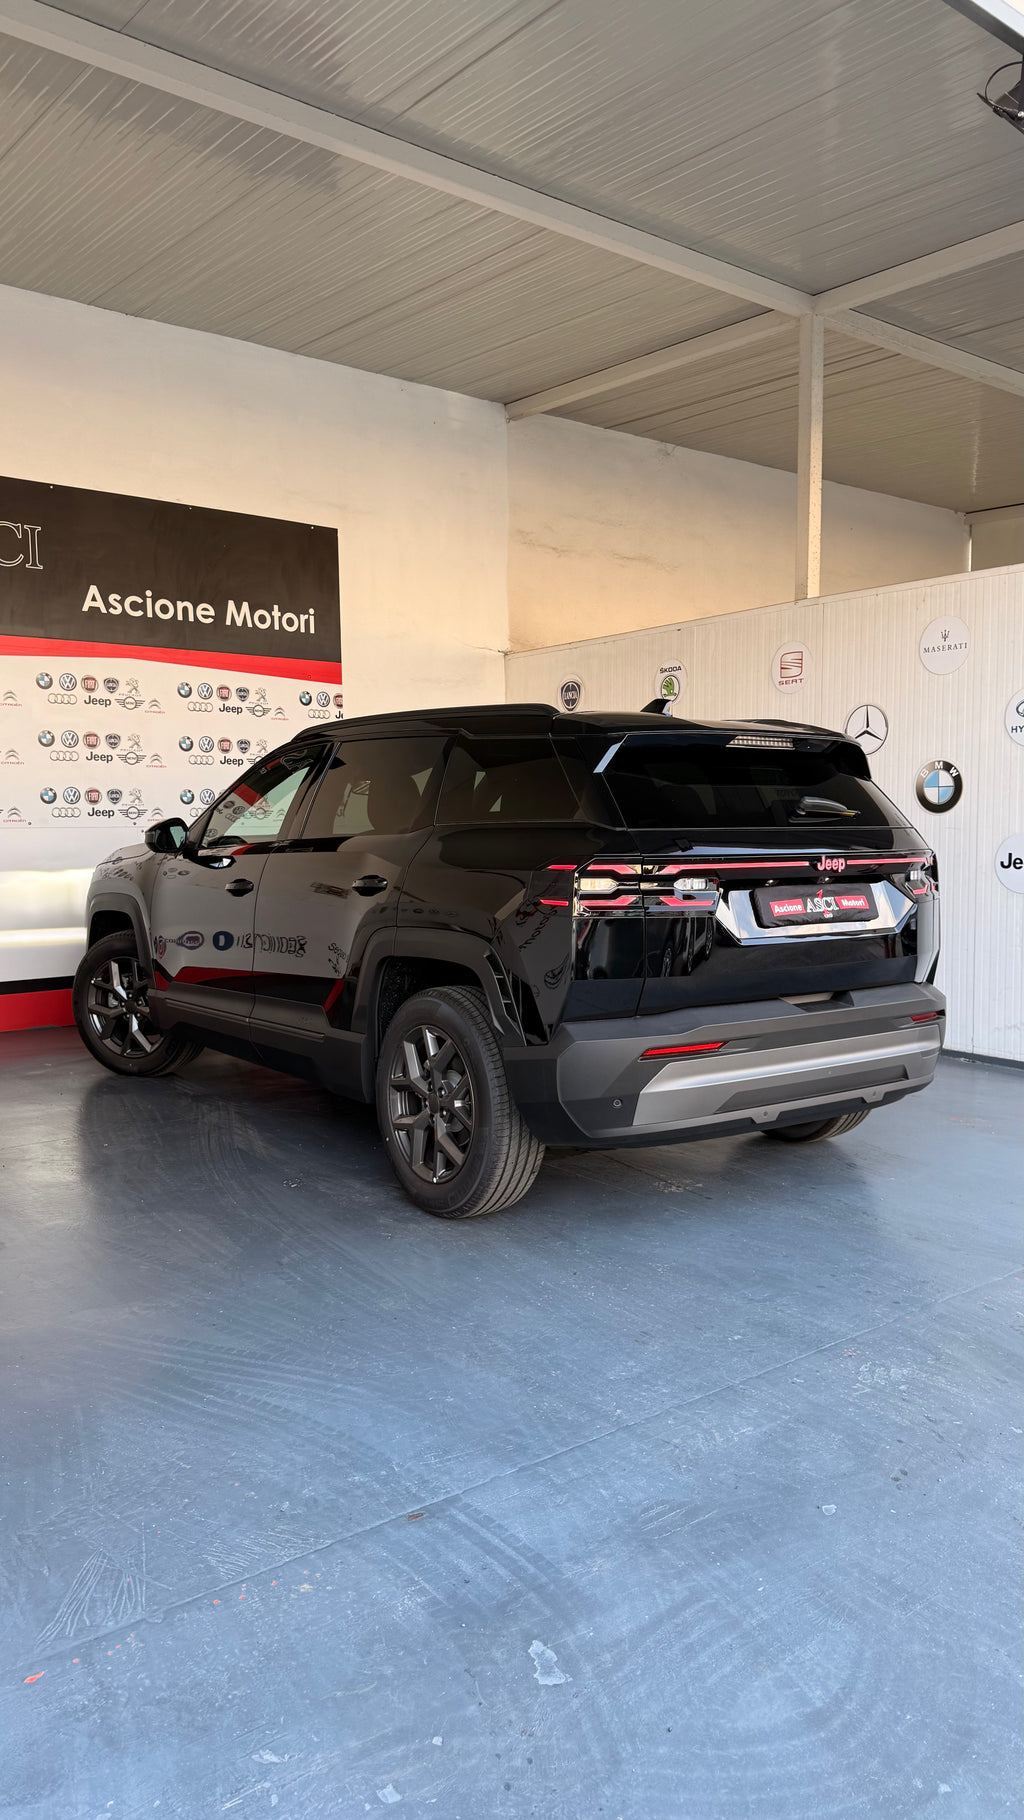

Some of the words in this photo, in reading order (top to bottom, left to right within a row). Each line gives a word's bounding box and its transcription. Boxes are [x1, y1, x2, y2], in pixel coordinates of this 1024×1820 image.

[82, 584, 215, 624] Ascione
[225, 600, 315, 634] Motori
[923, 642, 967, 653] MASERATI
[778, 678, 804, 686] SEAT
[84, 695, 111, 708] Jeep
[219, 703, 243, 715] Jeep
[86, 751, 114, 763] Jeep
[220, 756, 244, 767] Jeep
[87, 807, 115, 818] Jeep
[817, 855, 845, 872] Jeep
[1000, 852, 1024, 869] Je
[774, 904, 803, 914] Ascione
